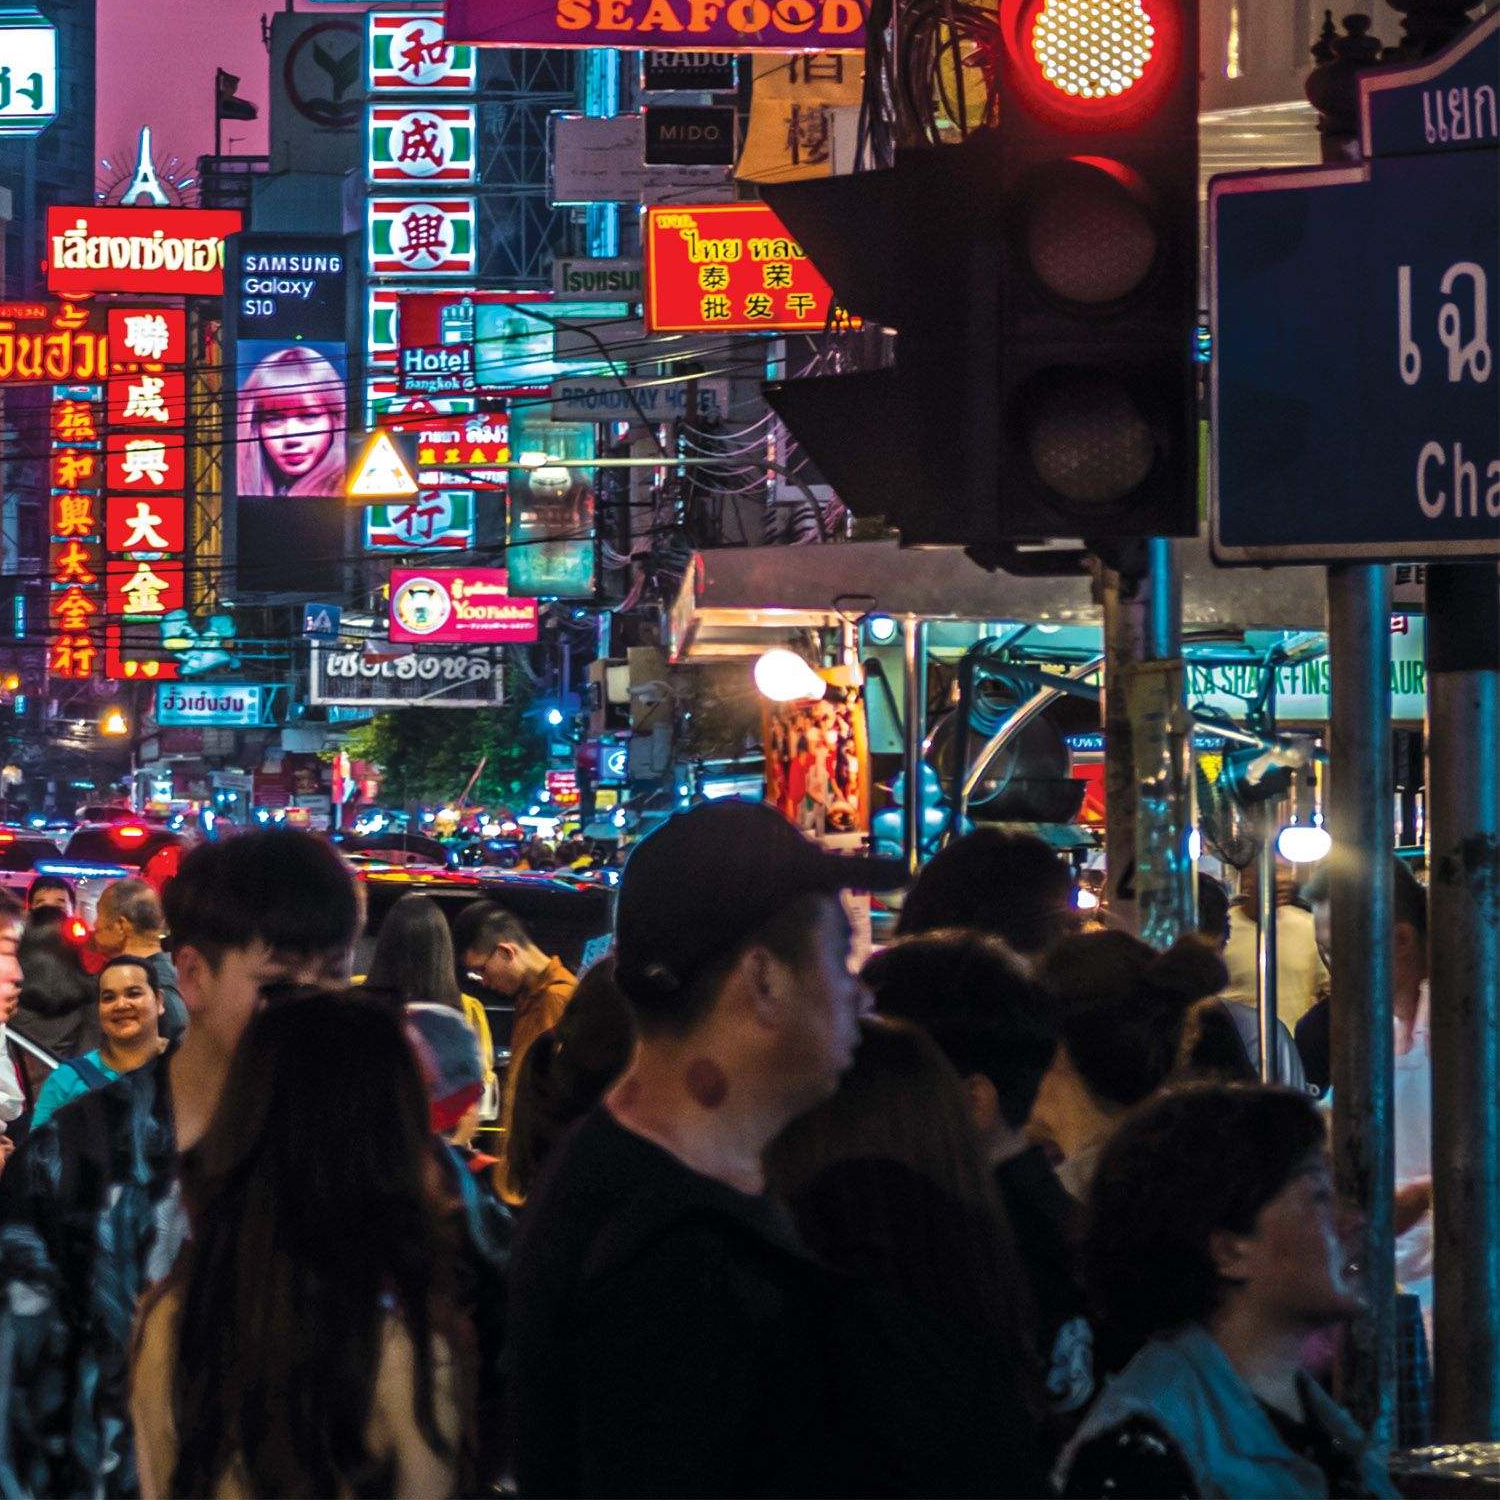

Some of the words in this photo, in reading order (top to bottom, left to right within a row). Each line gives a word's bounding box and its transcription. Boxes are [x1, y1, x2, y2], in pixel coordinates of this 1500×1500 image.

[1423, 85, 1498, 144] แยก
[660, 125, 719, 141] MIDO
[246, 255, 341, 272] SAMSUNG
[246, 277, 313, 297] Galaxy
[393, 28, 448, 539] 和成興行
[246, 299, 274, 316] S10
[405, 348, 470, 371] Hotel
[663, 388, 721, 410] HOEL
[1222, 660, 1330, 695] SHAK-FINS
